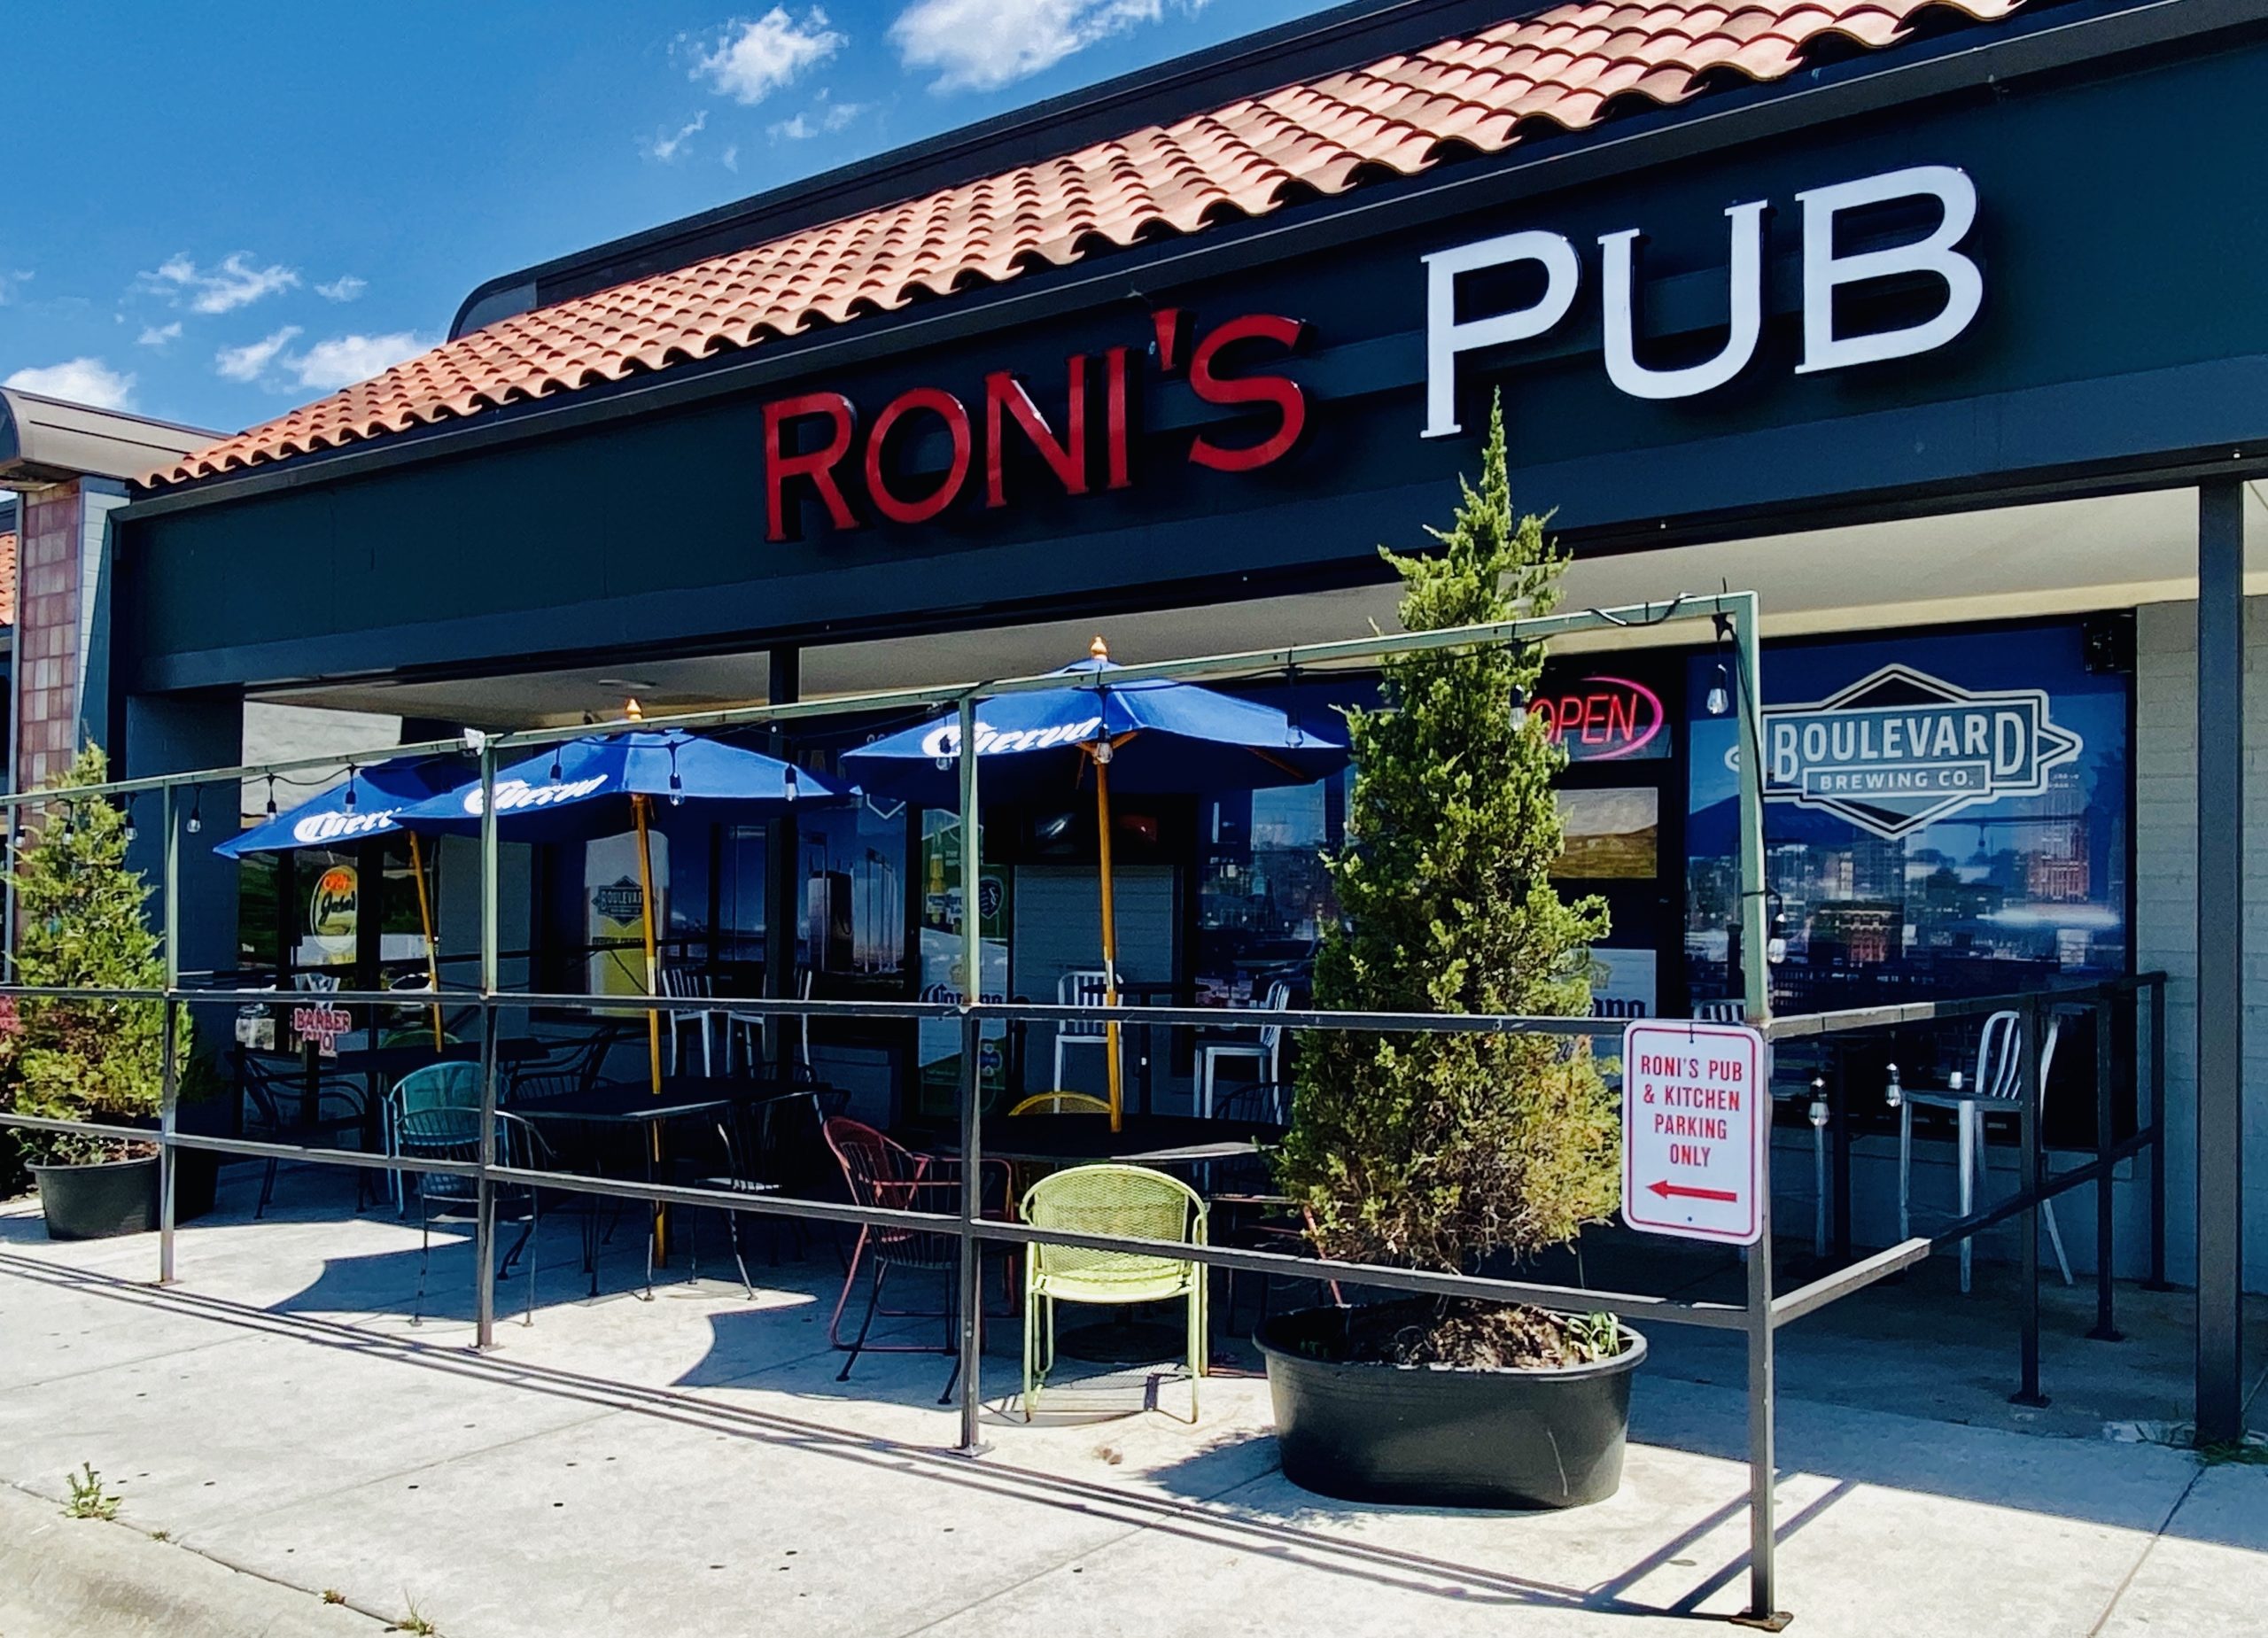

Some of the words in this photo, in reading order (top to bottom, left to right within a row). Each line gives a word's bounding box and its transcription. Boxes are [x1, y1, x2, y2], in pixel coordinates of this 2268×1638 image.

[762, 308, 1307, 542] RONI'S
[1419, 164, 1984, 440] PUB
[1530, 693, 1638, 744] OPEN
[1773, 710, 2026, 783] BOULEVARD
[1820, 770, 1929, 791] BREWING
[1938, 769, 1976, 788] CO.
[296, 1009, 351, 1033] BARBER
[1641, 1054, 1699, 1079] RONI'S
[1708, 1060, 1743, 1082] PUB
[1643, 1083, 1655, 1104] &
[1665, 1085, 1740, 1112] KITCHEN
[1655, 1113, 1727, 1140] PARKING
[1669, 1143, 1711, 1168] ONLY
